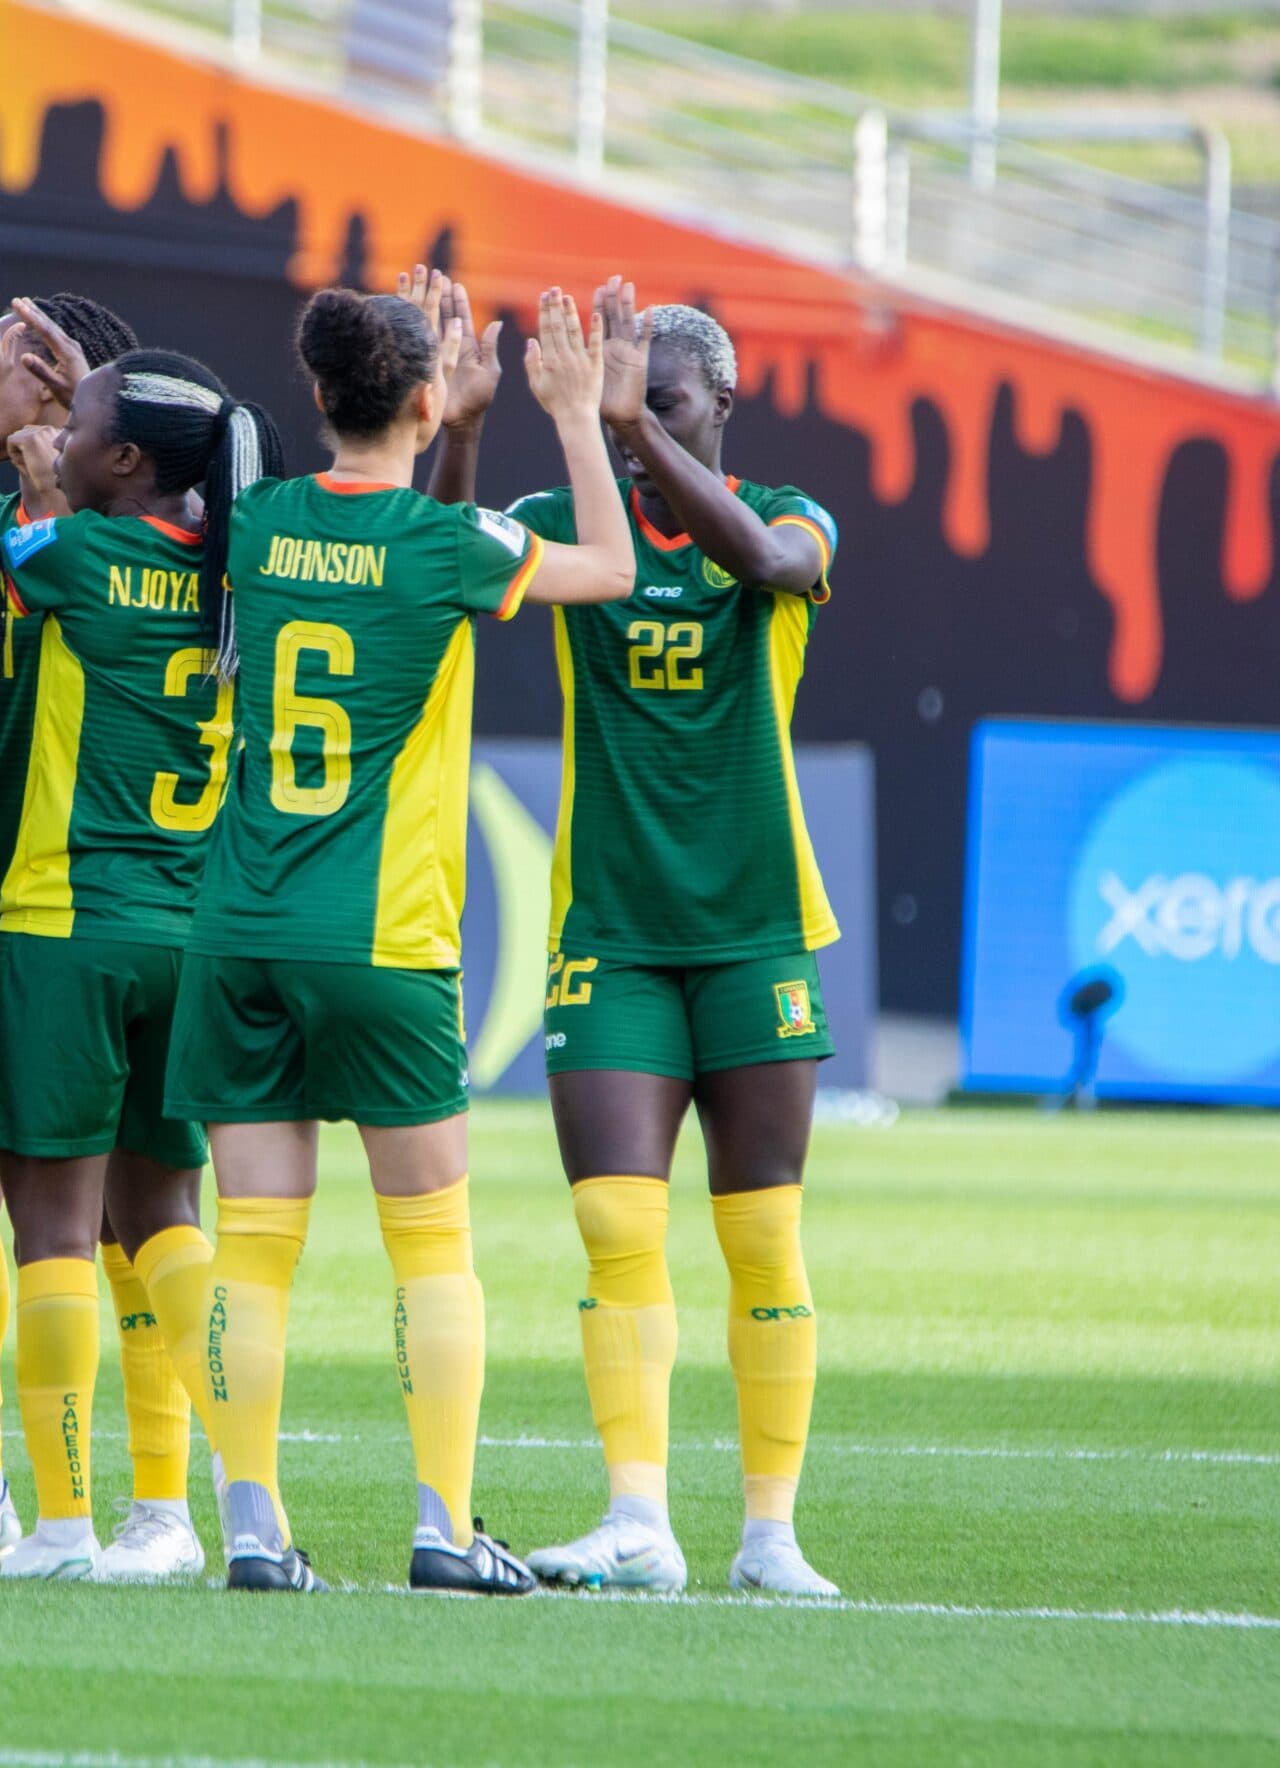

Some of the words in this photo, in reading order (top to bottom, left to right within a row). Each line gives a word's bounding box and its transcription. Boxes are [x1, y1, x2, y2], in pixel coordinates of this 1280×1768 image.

[259, 535, 387, 587] JOHNSON
[643, 585, 683, 599] one
[626, 620, 704, 691] 22
[150, 647, 235, 833] 3
[270, 620, 355, 816] 6
[208, 1286, 229, 1402] CAMEROUN
[394, 1286, 414, 1396] CAMEROUN
[751, 1304, 813, 1322] one
[61, 1392, 85, 1500] CAMEROUN
